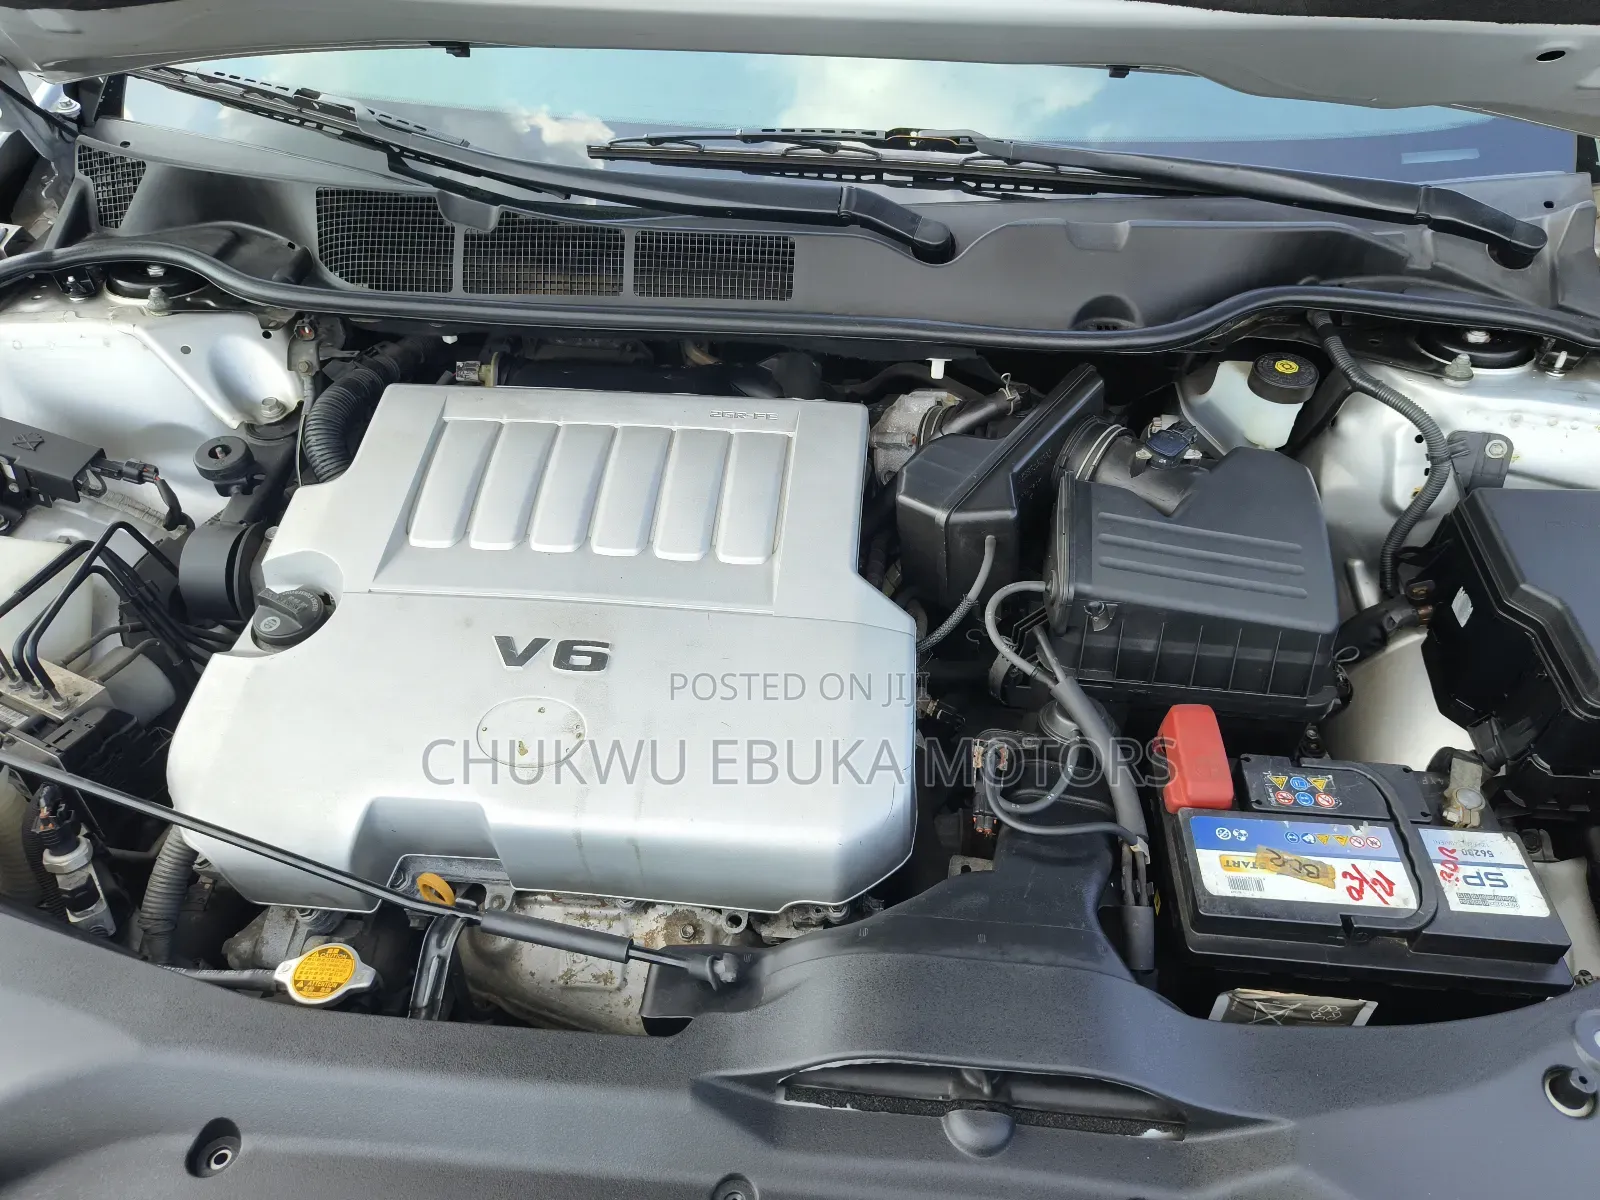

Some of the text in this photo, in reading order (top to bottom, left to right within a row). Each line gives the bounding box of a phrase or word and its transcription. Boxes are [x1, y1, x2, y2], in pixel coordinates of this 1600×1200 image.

[709, 410, 778, 421] 2GR-FE
[491, 635, 611, 673] V6
[1461, 871, 1509, 888] SP
